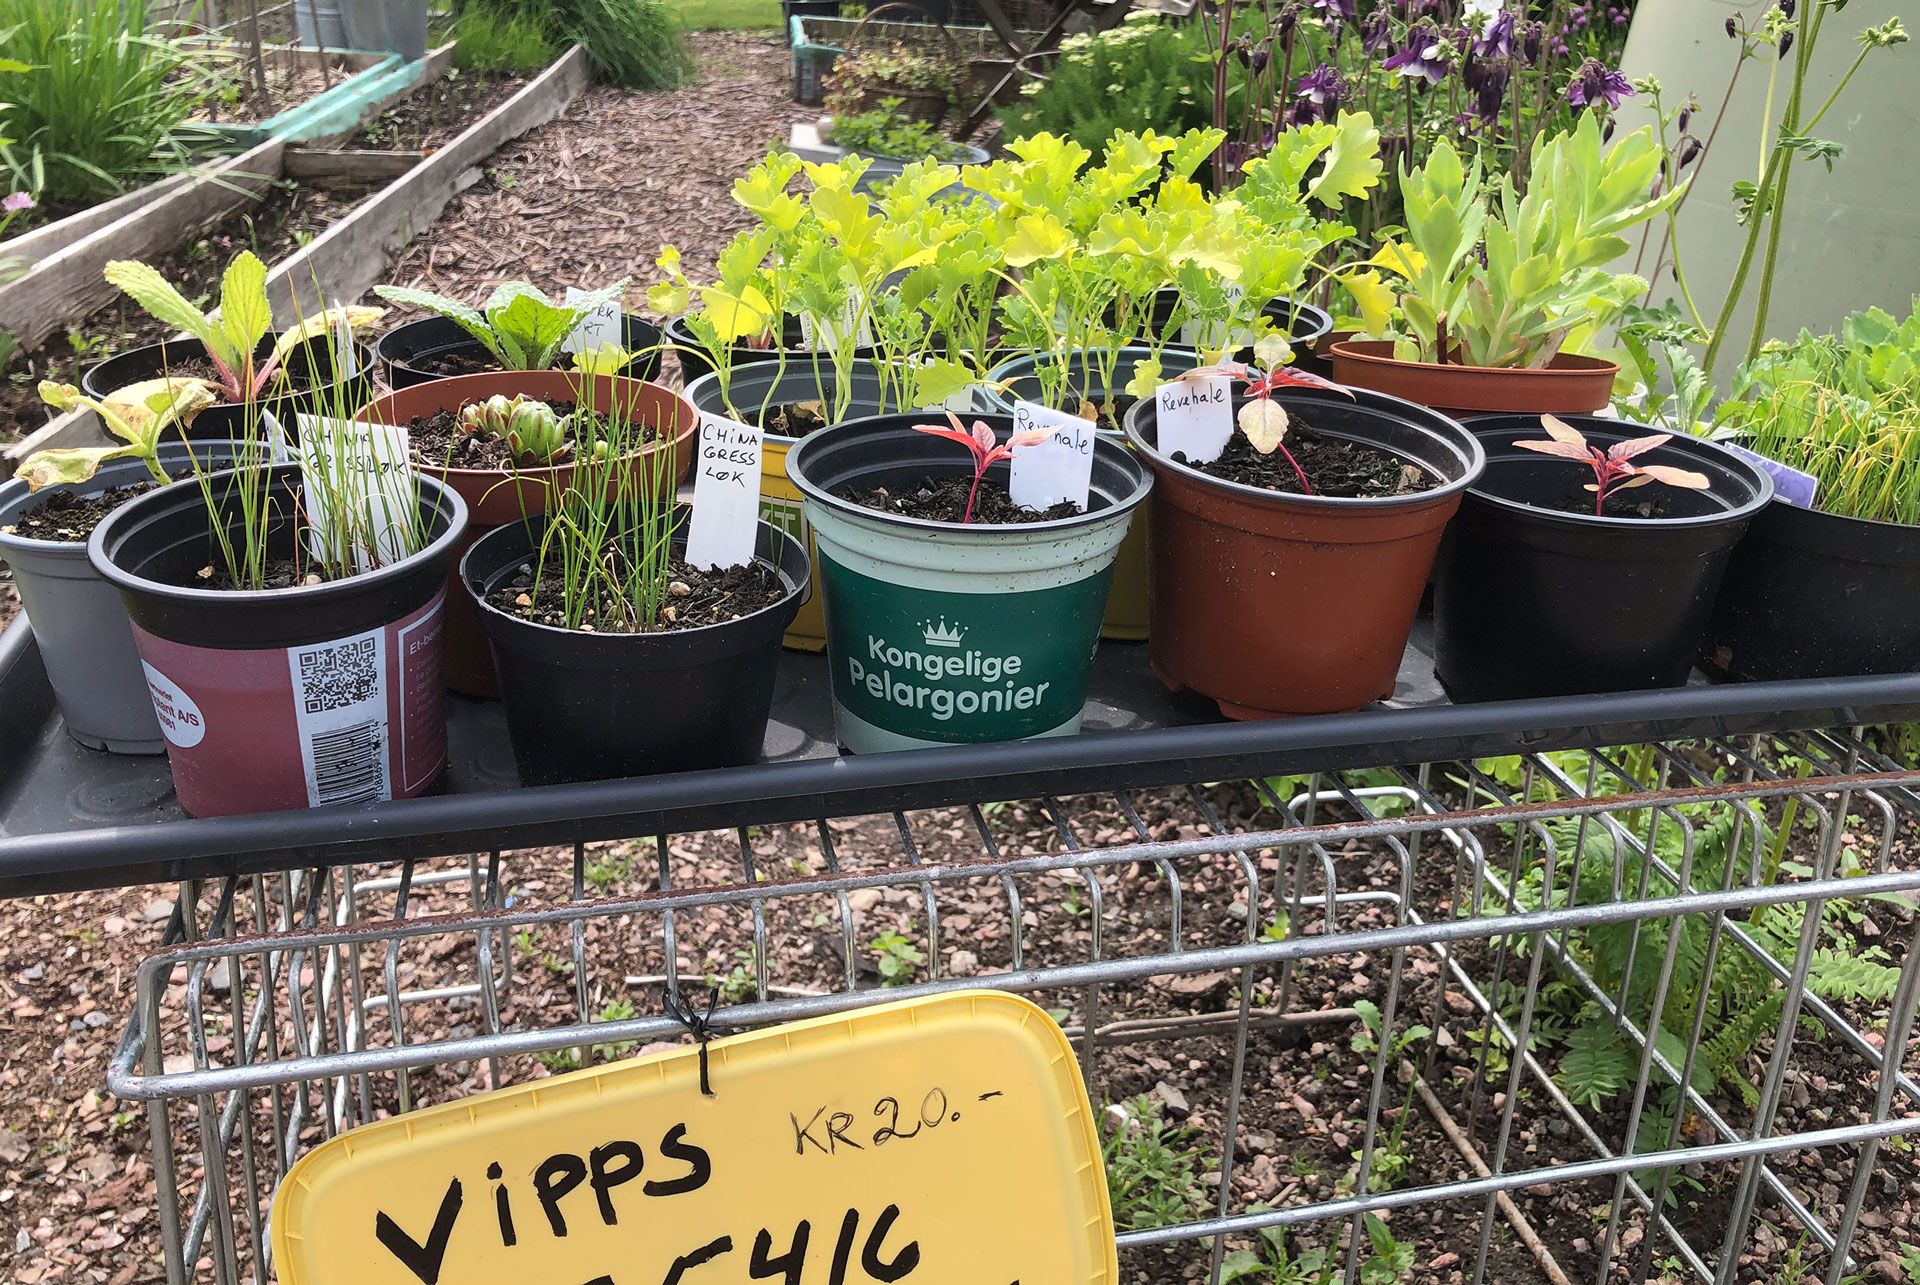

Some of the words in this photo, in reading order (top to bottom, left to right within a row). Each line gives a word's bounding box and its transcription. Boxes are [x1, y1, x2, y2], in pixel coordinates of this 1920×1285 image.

[703, 446, 756, 466] GRESS
[705, 466, 745, 488] LØK
[868, 635, 1022, 683] Kongelige
[849, 656, 1050, 721] Pelargonier
[178, 709, 200, 727] A/S
[370, 719, 382, 757] 1214
